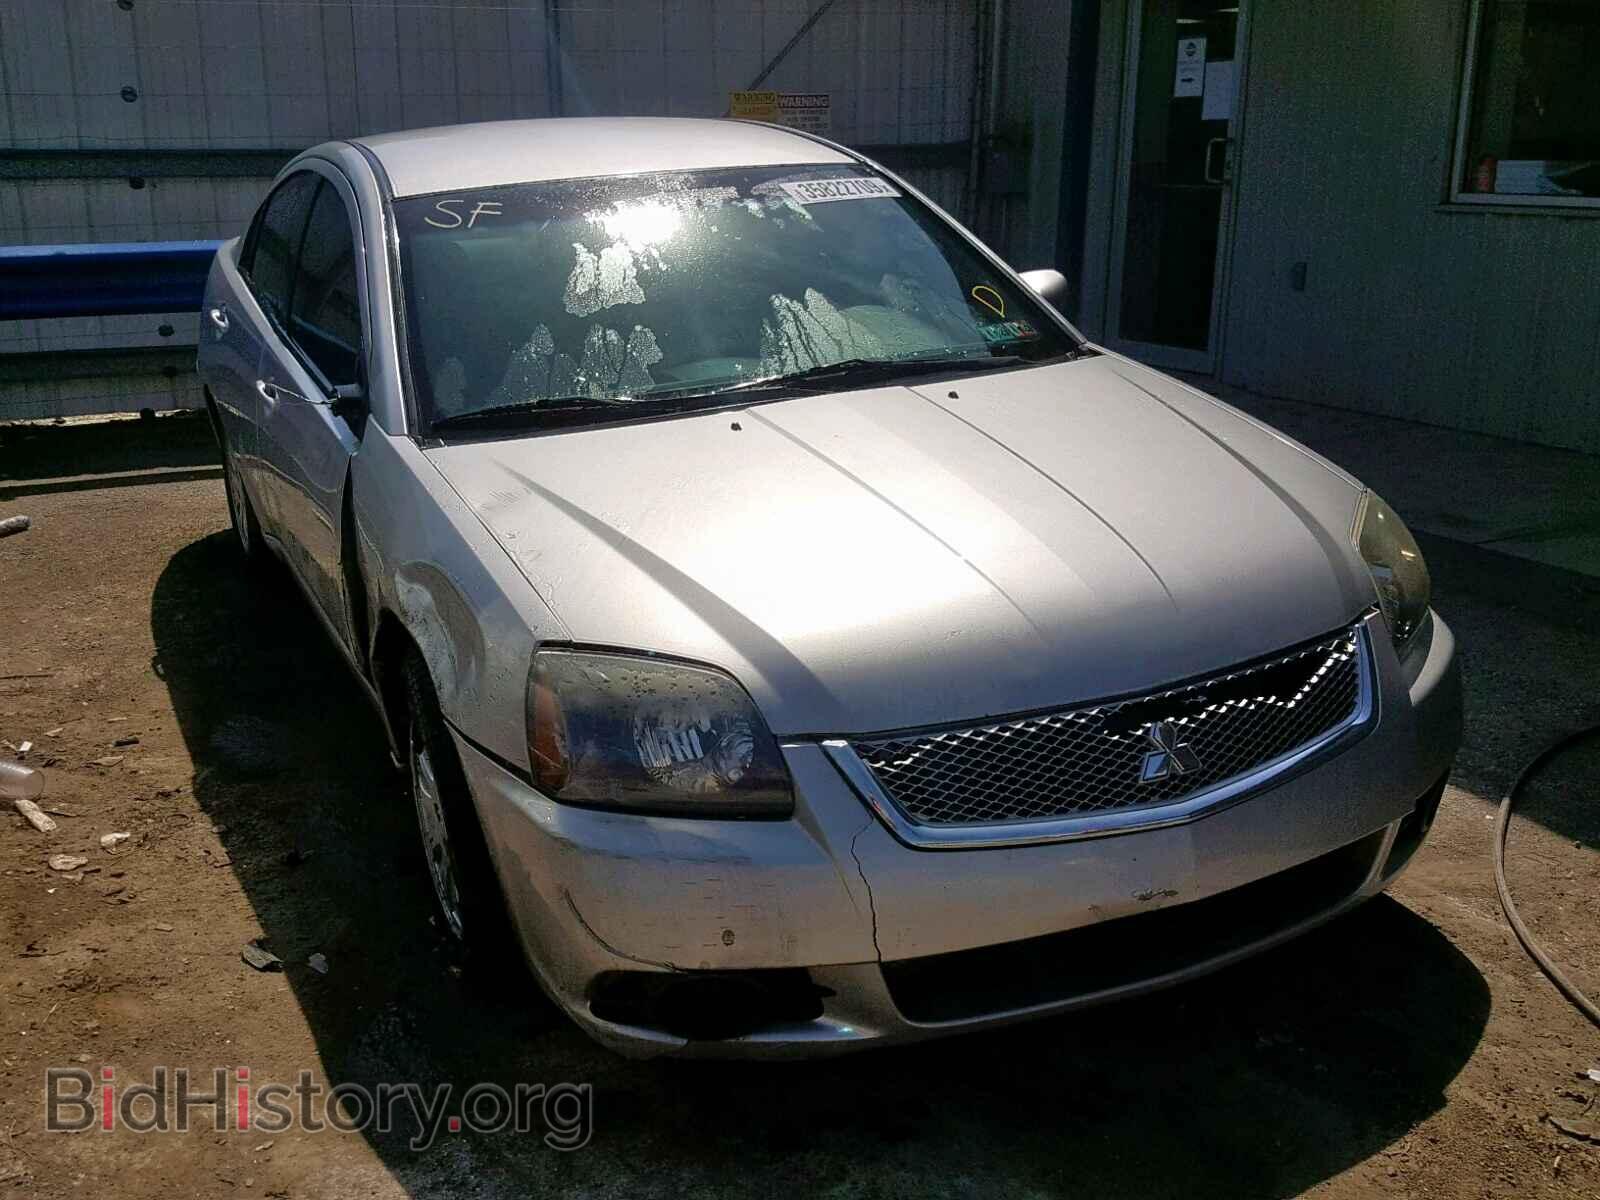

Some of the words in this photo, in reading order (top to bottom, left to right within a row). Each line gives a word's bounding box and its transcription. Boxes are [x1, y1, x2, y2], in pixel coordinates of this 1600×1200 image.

[779, 95, 829, 107] WARNING
[798, 179, 883, 199] 35822709
[424, 199, 503, 229] SF
